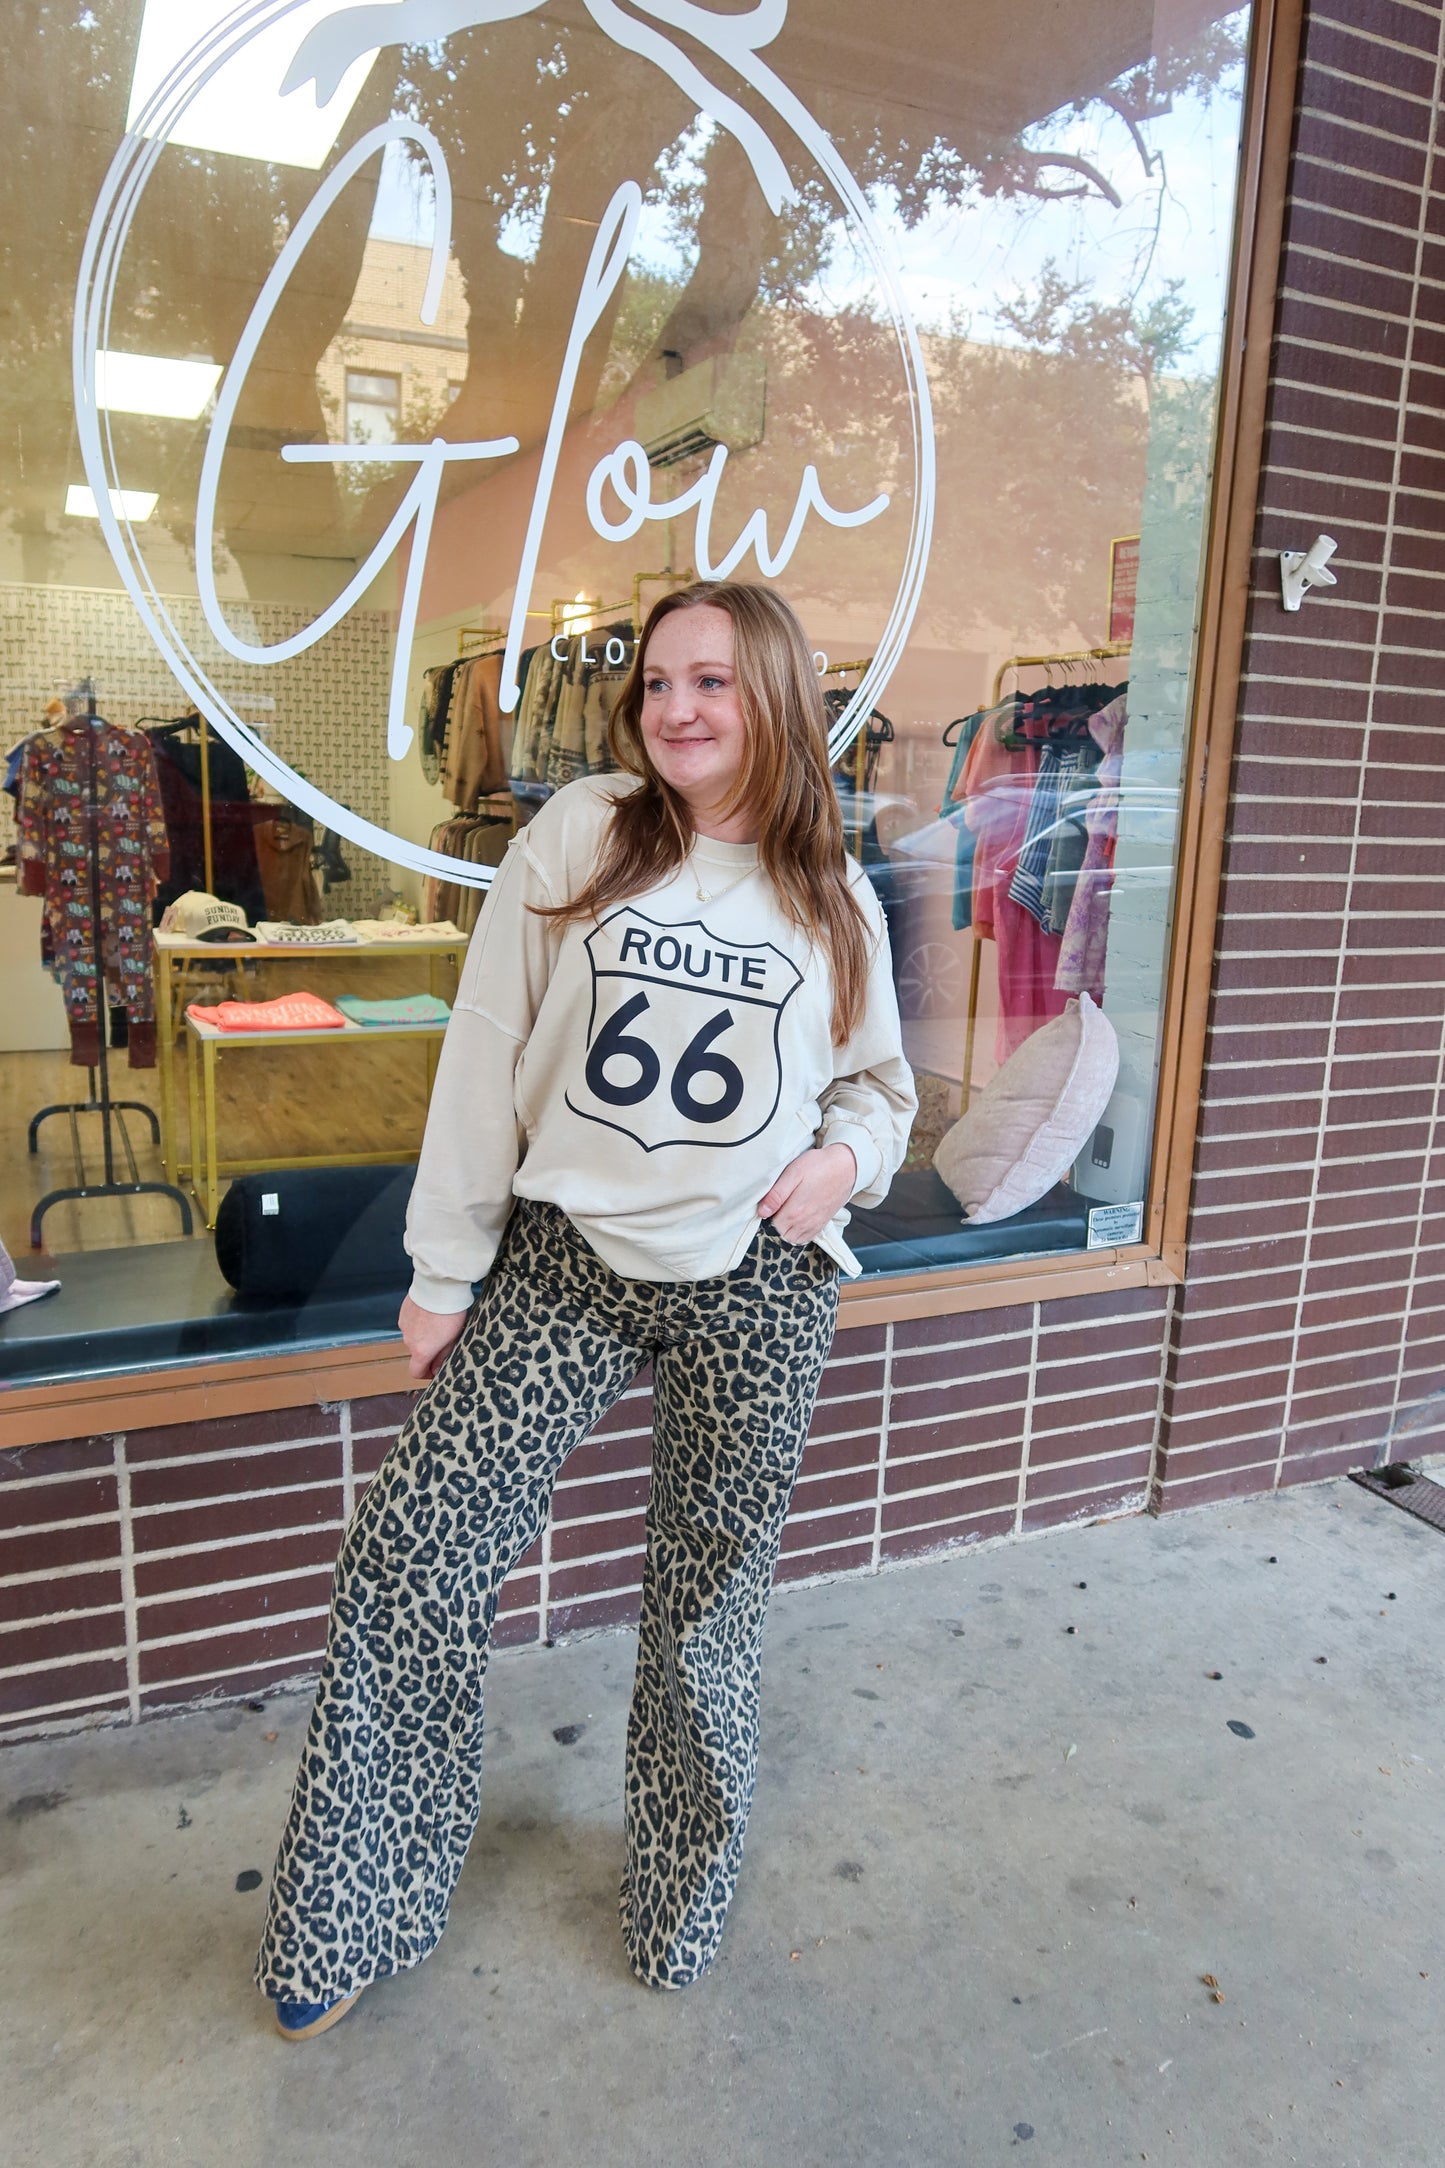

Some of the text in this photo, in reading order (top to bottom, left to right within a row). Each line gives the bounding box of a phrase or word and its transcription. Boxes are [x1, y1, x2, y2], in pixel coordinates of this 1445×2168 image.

[194, 119, 890, 761] Glow
[551, 634, 641, 664] CLO
[204, 905, 238, 916] SUNDAY
[206, 914, 240, 925] FUNDAY
[618, 926, 767, 991] ROUTE
[585, 990, 744, 1124] 66
